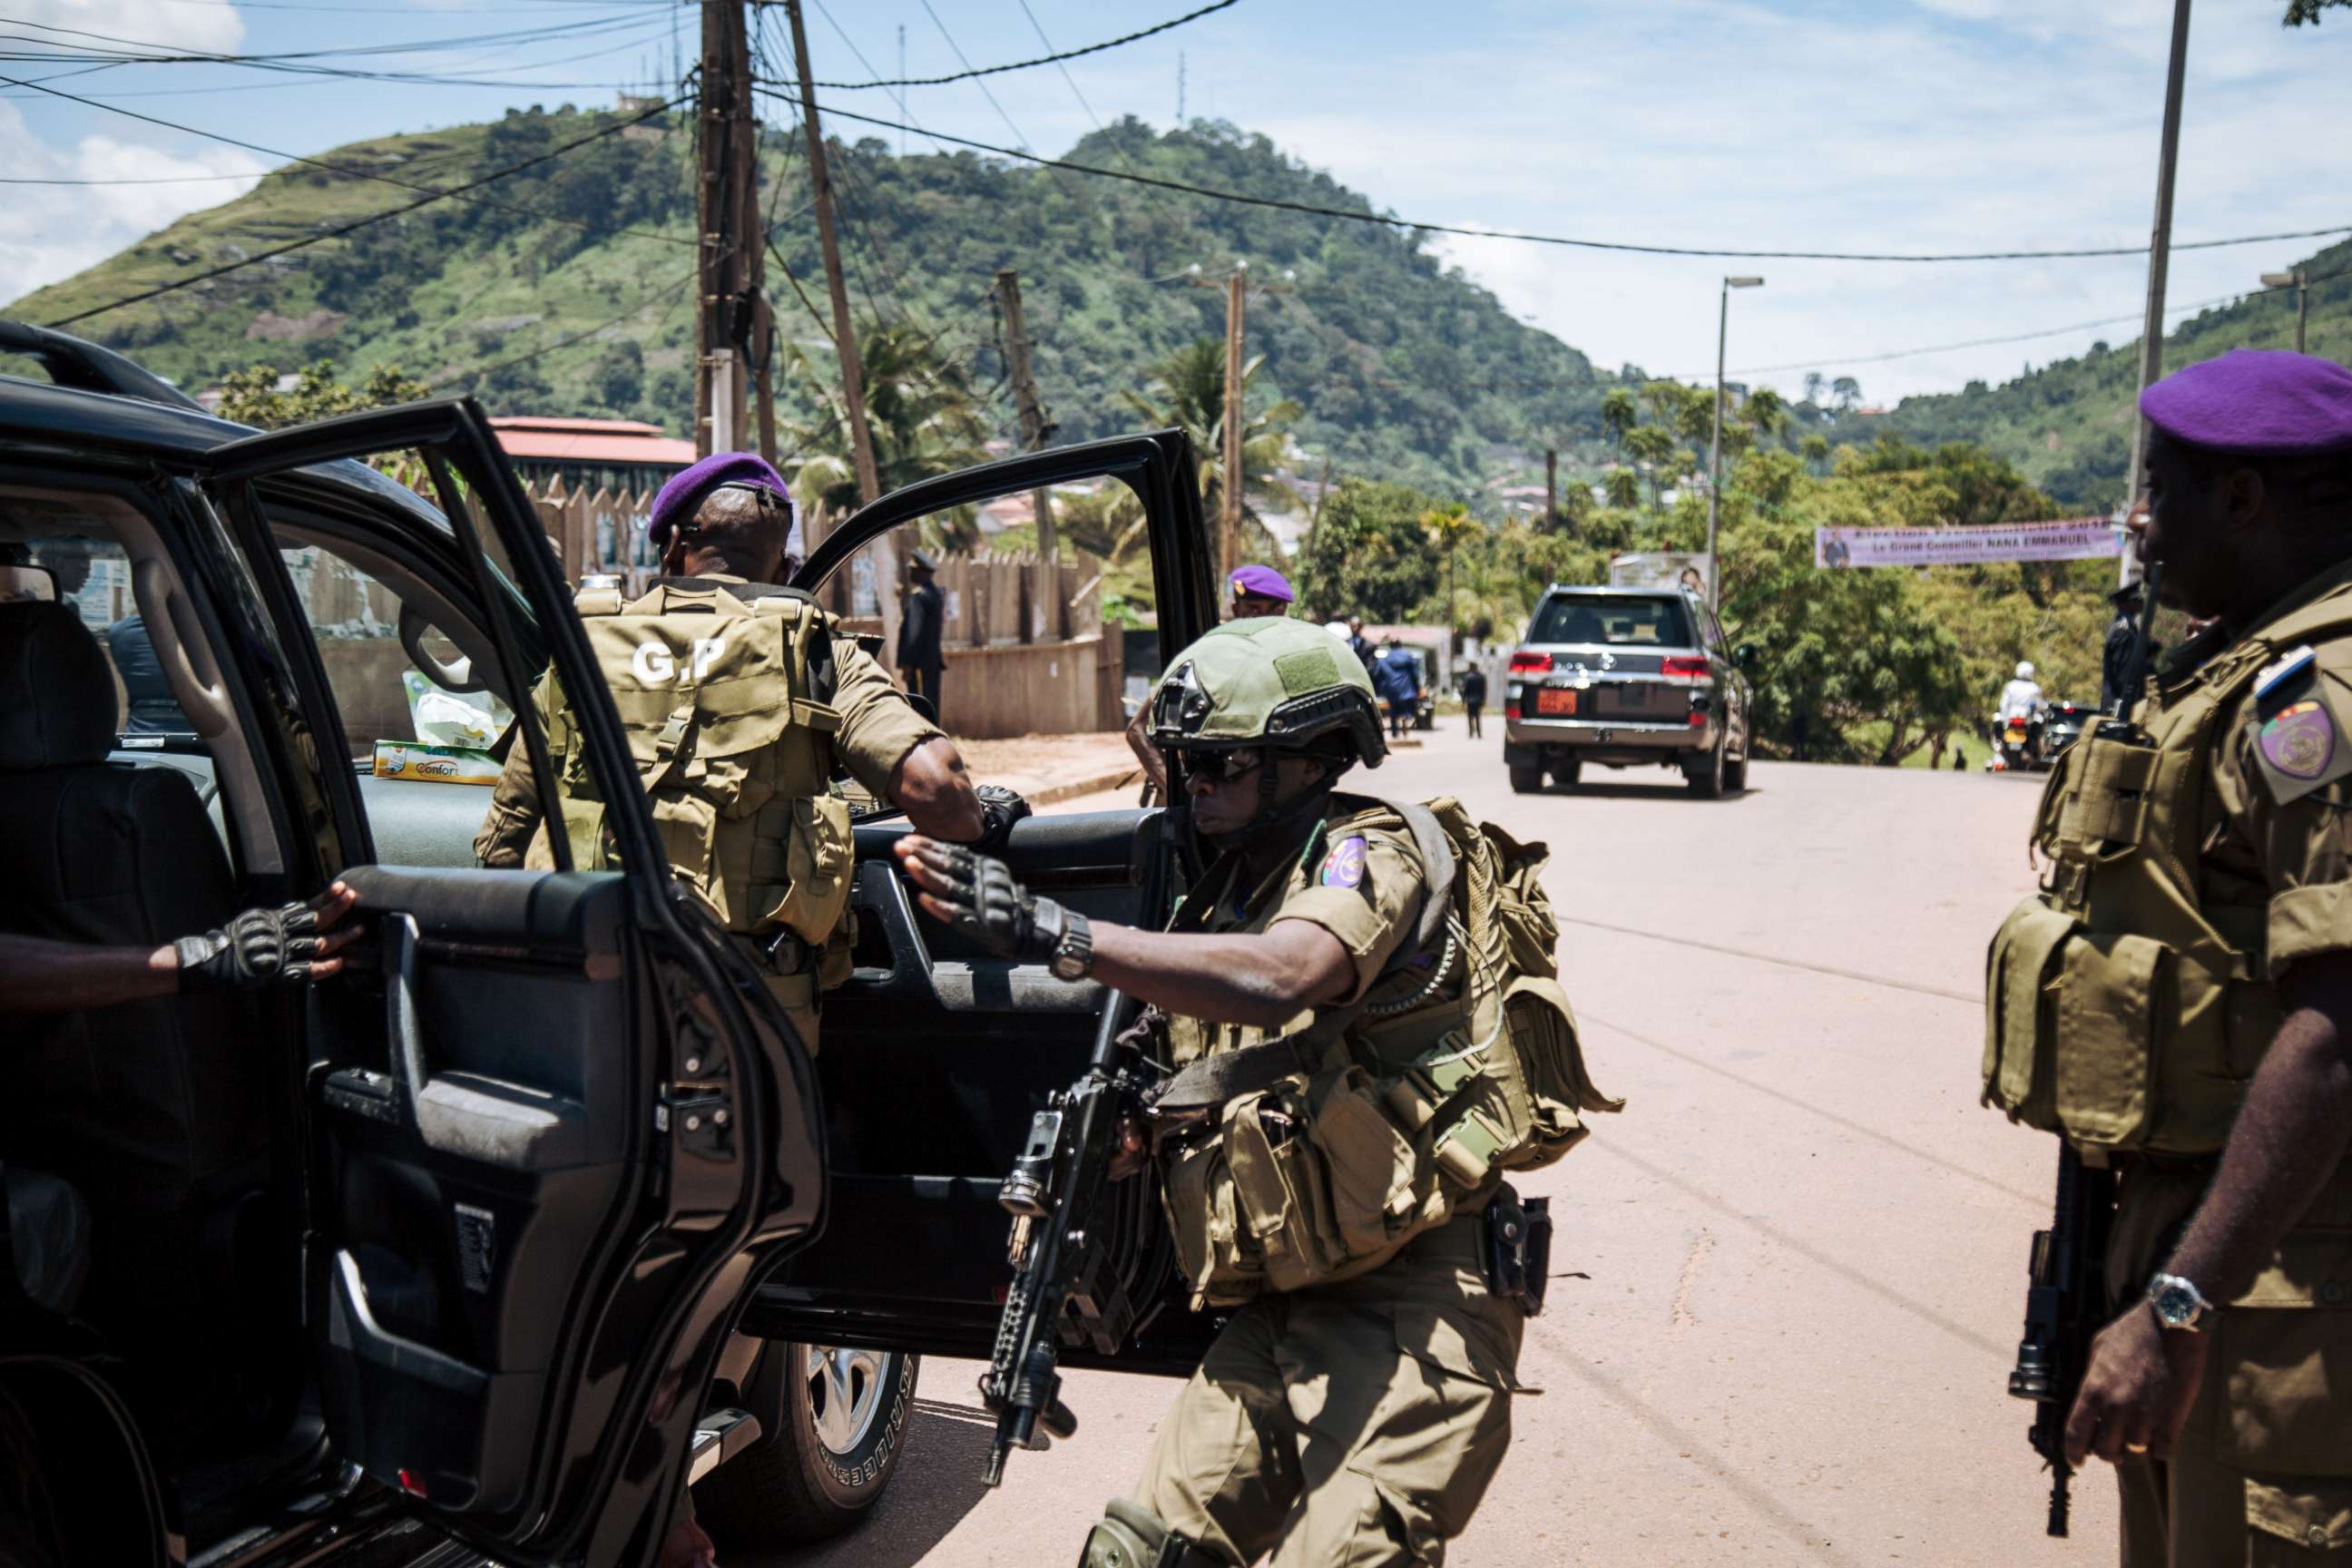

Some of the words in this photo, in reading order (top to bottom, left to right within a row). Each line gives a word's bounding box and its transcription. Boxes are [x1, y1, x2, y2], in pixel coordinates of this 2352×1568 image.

[1987, 537, 2019, 548] NANA
[2024, 534, 2091, 545] EMMANUEL
[632, 638, 726, 682] G.P
[416, 762, 459, 777] Confort
